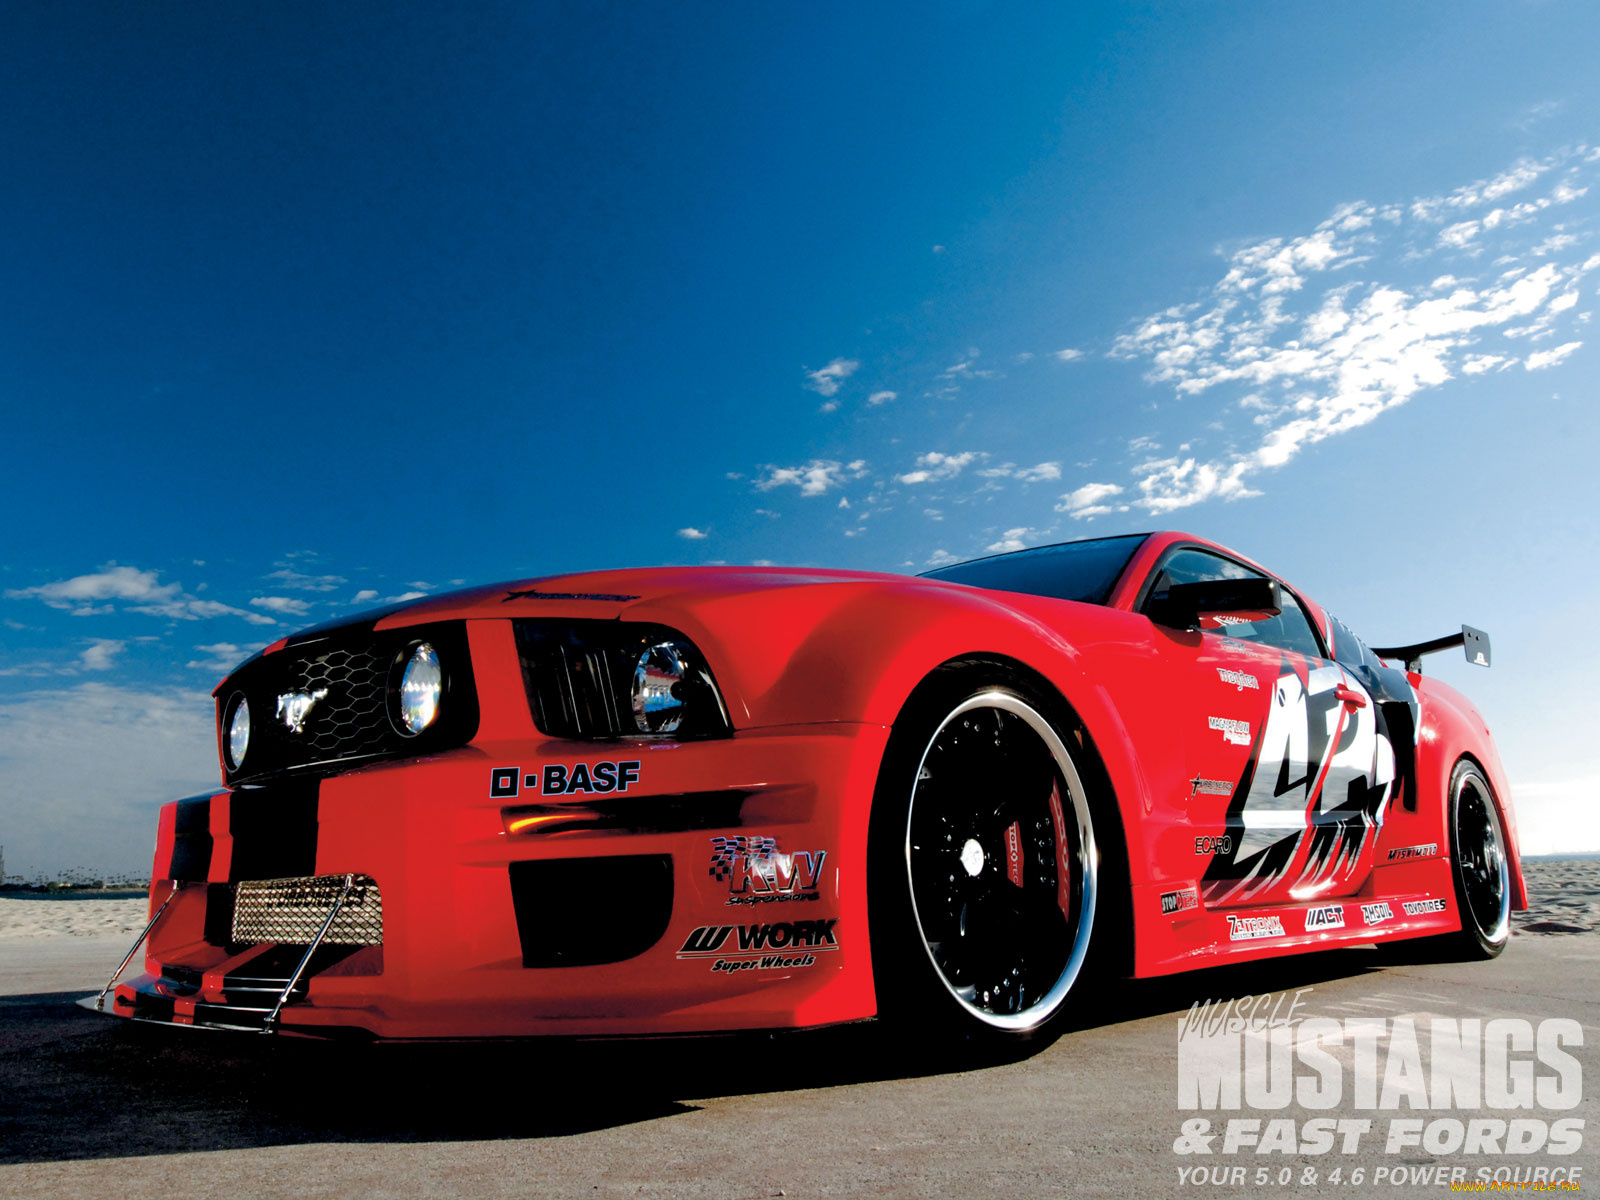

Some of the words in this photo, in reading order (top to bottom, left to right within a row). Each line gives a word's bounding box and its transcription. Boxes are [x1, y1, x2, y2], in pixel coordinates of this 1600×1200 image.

[542, 760, 641, 796] BASF
[1195, 835, 1232, 855] ECARO
[729, 851, 827, 894] KW
[1162, 895, 1177, 912] STOP
[737, 919, 840, 950] WORK
[711, 958, 757, 973] Super
[758, 953, 815, 970] Wheels
